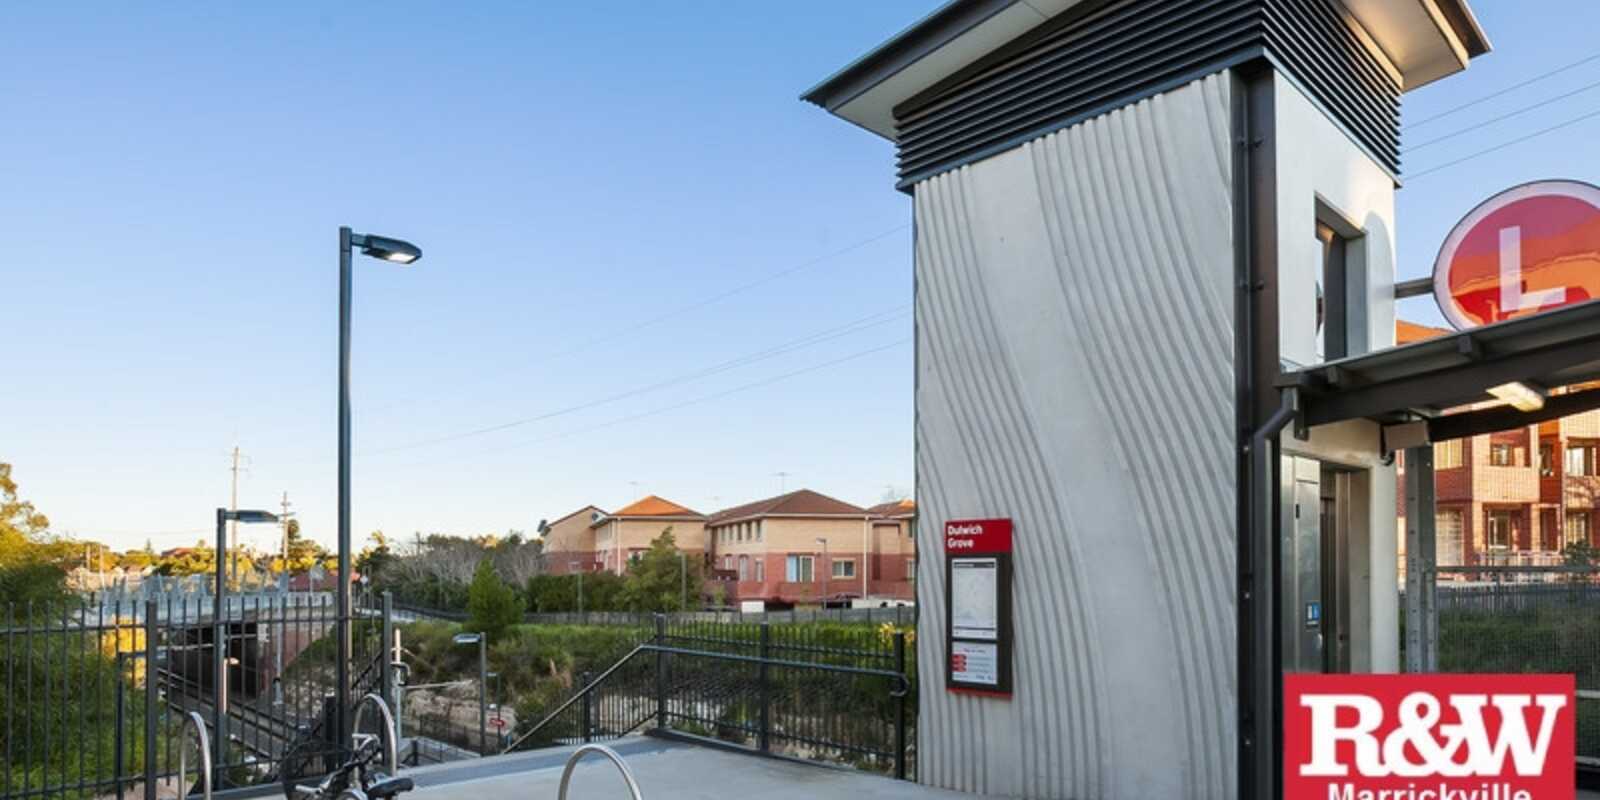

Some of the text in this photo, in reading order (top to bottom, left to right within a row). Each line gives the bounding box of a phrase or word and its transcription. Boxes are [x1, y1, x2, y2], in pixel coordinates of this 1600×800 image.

[1499, 225, 1567, 313] L
[947, 524, 983, 535] Dulwich
[947, 537, 974, 548] Grove
